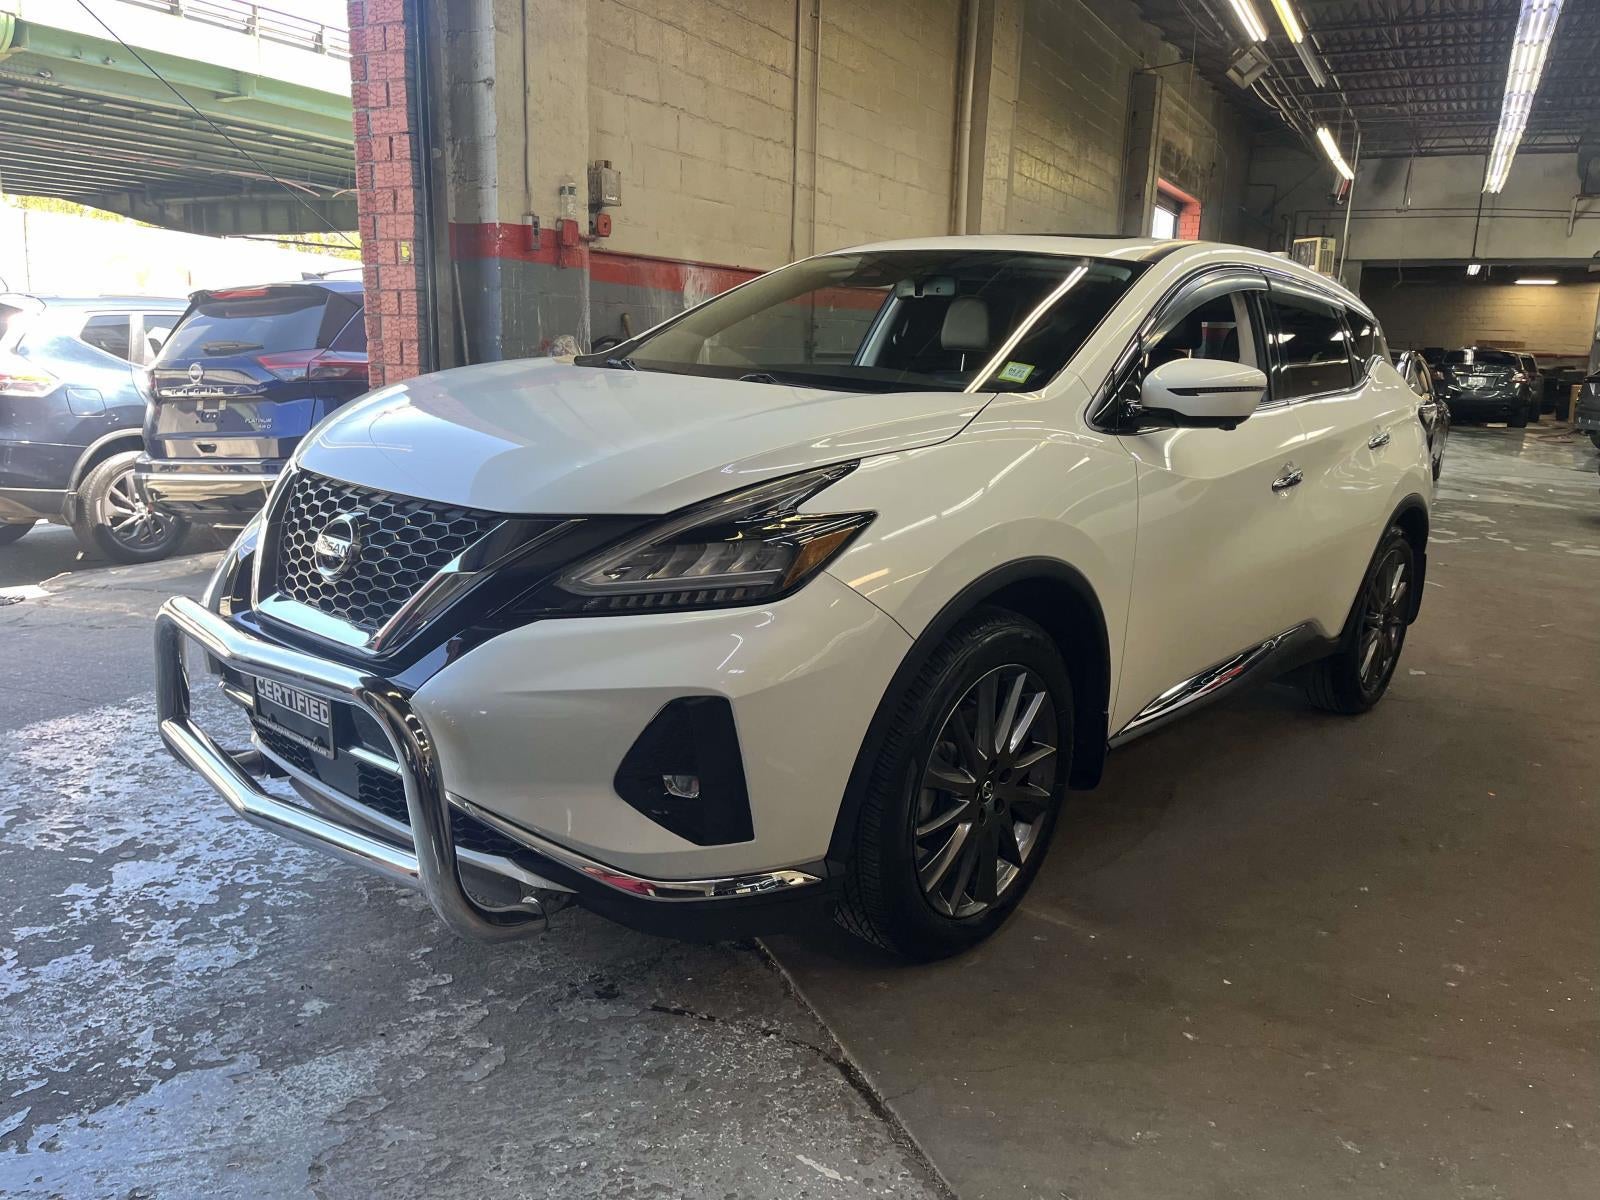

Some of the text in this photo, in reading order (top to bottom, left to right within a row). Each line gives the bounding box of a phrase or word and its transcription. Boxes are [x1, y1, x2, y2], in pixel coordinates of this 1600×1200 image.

[171, 387, 224, 395] ROGUE
[316, 534, 349, 556] SSAN
[256, 677, 329, 724] CERTIFIED
